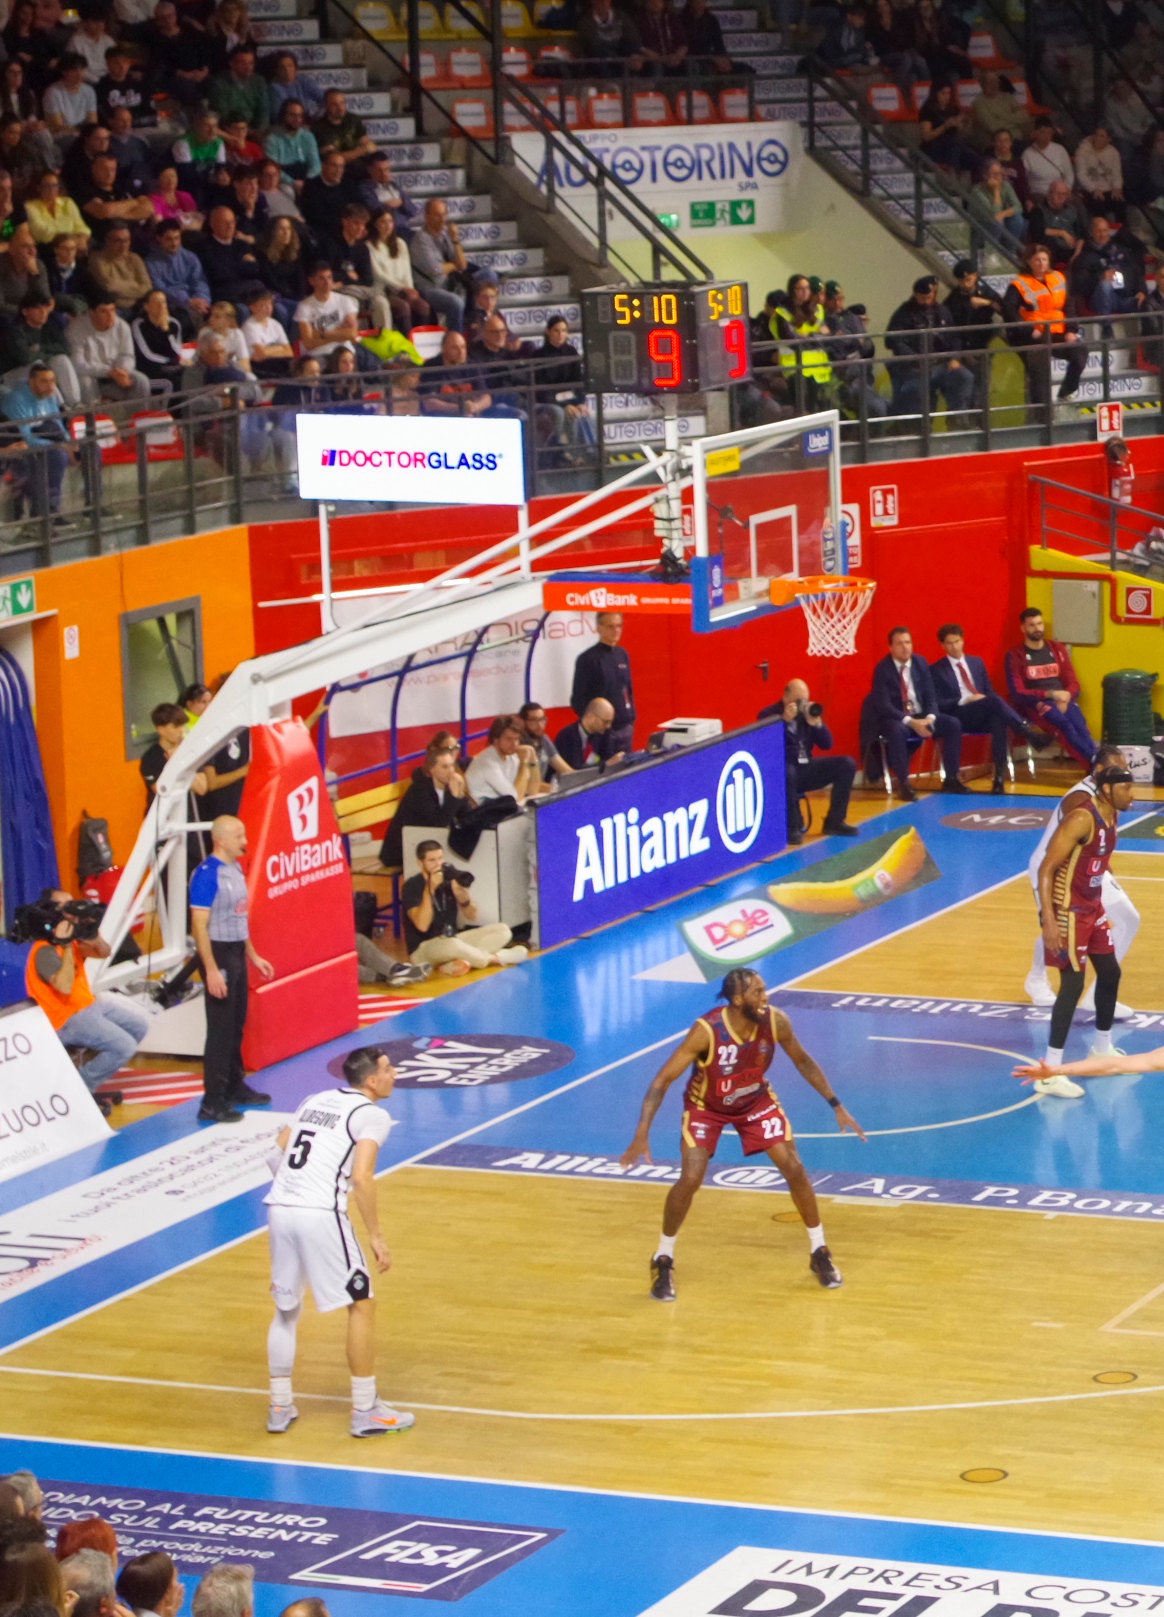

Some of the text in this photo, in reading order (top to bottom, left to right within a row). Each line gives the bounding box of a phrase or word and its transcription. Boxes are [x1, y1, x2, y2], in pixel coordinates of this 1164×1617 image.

[566, 132, 618, 146] RUPPO
[737, 181, 760, 192] SPA
[614, 294, 678, 325] 5:10
[708, 285, 743, 321] 5:10
[647, 328, 683, 388] 9
[725, 319, 747, 379] 9
[602, 418, 690, 441] AUTOTORO
[808, 430, 830, 449] Unipol
[265, 833, 344, 884] CiviBank
[572, 797, 711, 903] Allianz
[267, 865, 345, 900] GRUPPO SPARKASSE
[702, 904, 771, 946] Dole
[394, 1041, 505, 1084] SKY
[445, 1045, 551, 1087] ENERGY
[717, 1043, 739, 1066] 22
[0, 1093, 70, 1141] UOLO
[761, 1117, 784, 1139] 22
[288, 1129, 317, 1170] 5
[493, 1150, 685, 1181] Allianz
[840, 1176, 941, 1201] Ag.
[43, 1490, 328, 1529] DIAMO AL FUTURO
[104, 1511, 164, 1529] SUL
[168, 1518, 339, 1546] PRESENTE
[144, 1537, 275, 1560] produzione
[359, 1540, 482, 1570] FISA
[768, 1558, 1002, 1596] IMPRESA
